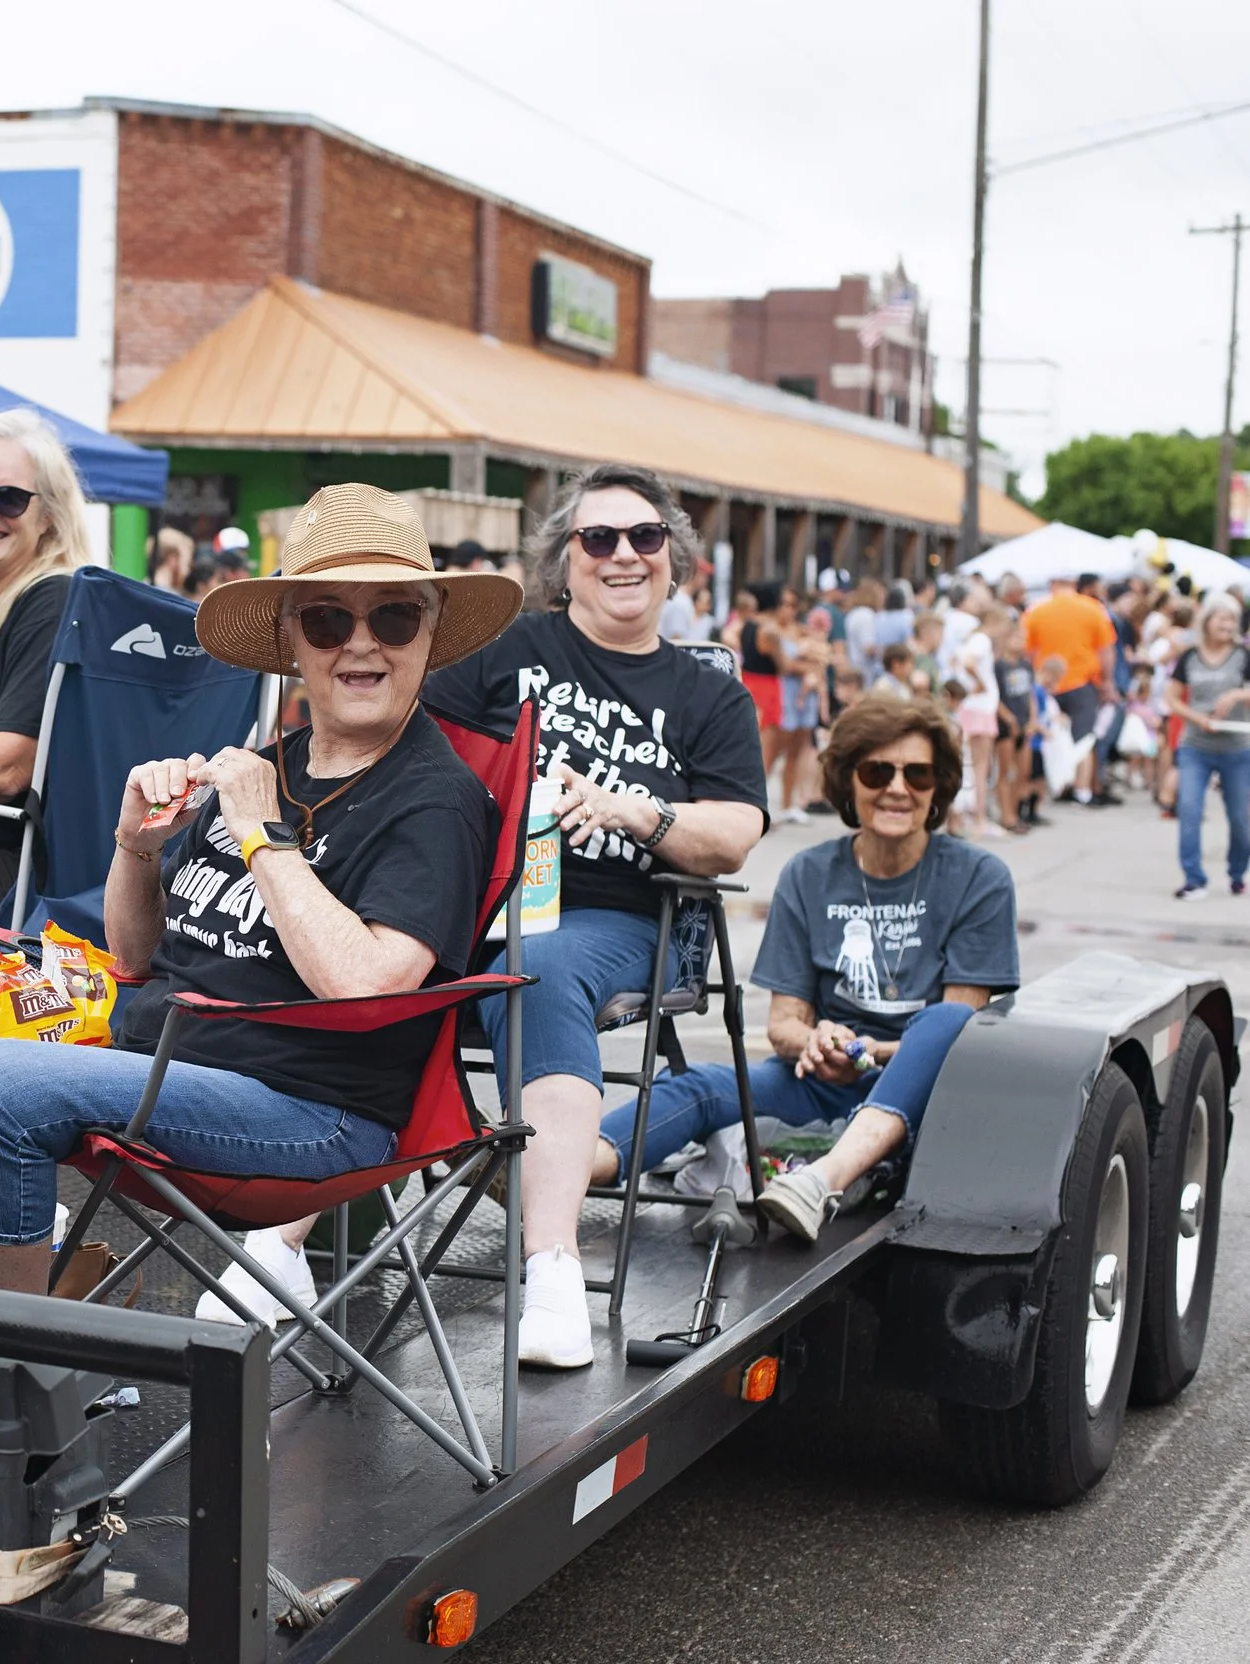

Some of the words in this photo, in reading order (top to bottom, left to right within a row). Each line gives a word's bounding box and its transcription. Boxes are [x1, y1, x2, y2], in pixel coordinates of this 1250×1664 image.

[524, 838, 559, 862] ORN
[522, 862, 554, 887] KET
[827, 899, 927, 920] FRONTENAC
